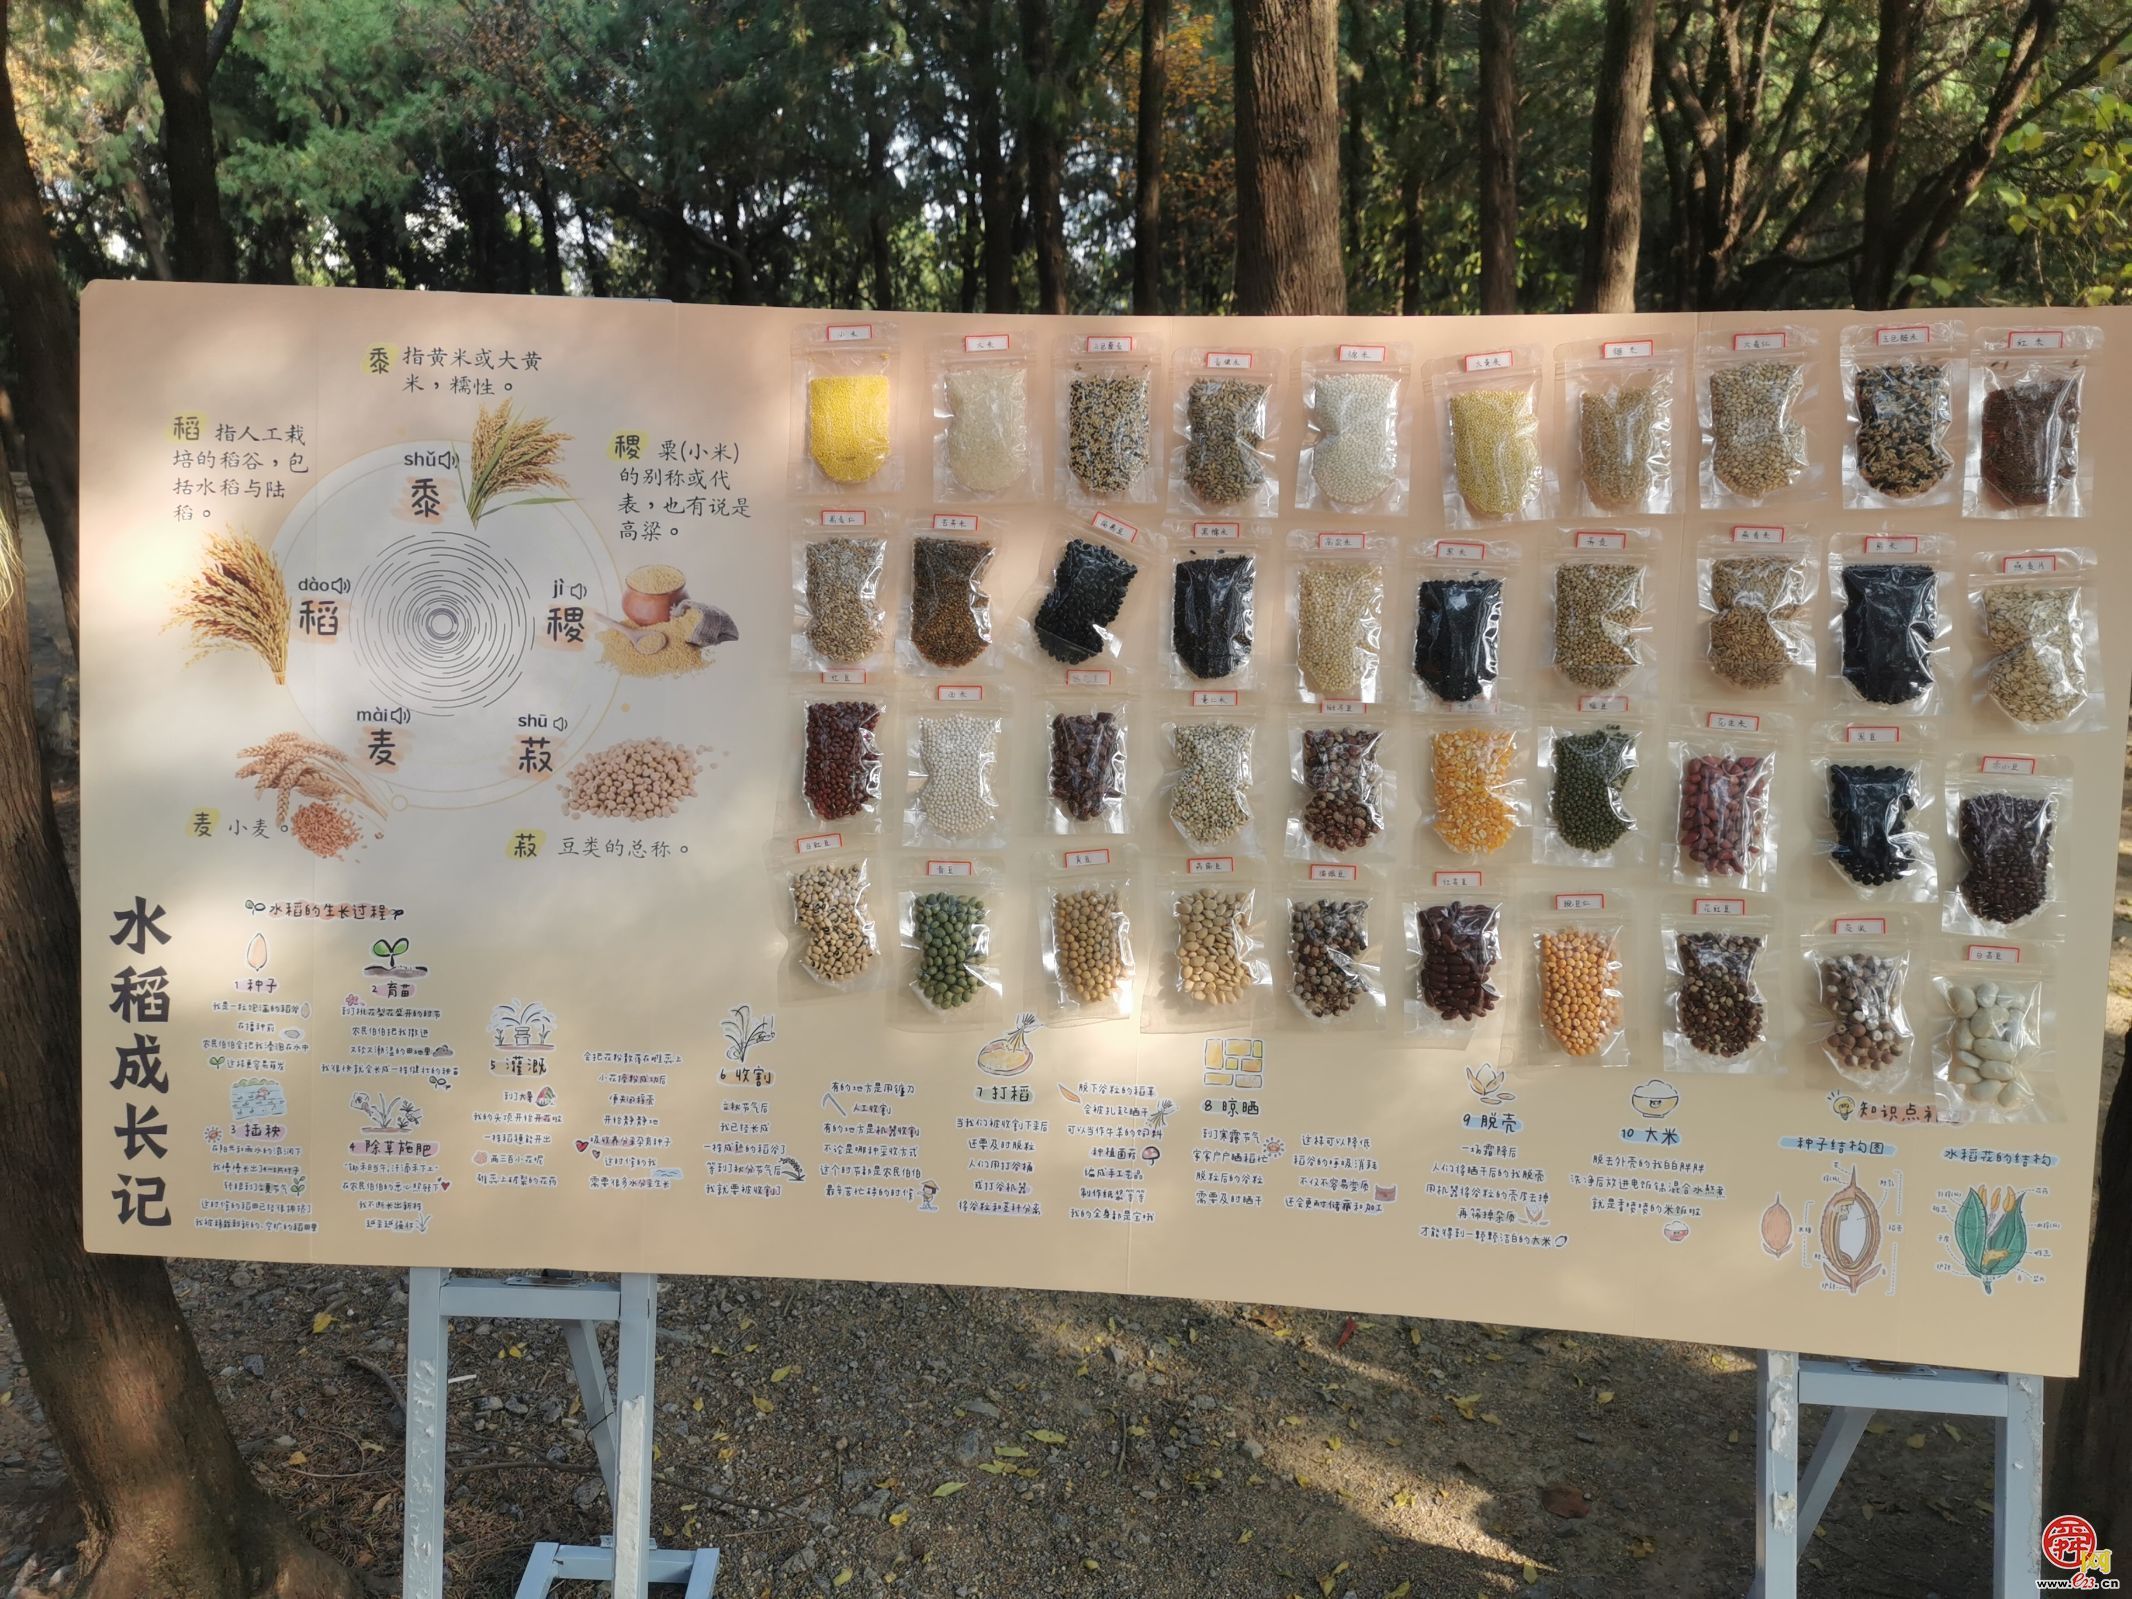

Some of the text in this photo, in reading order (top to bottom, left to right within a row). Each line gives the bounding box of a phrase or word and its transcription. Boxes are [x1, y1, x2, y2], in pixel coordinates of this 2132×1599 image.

[370, 347, 389, 374] 黍
[402, 346, 543, 373] 指黄米或大黄
[173, 415, 200, 441] 稻
[215, 424, 305, 445] 指人工栽
[615, 435, 640, 461] 稷
[173, 477, 286, 498] 括水稻与陆
[619, 467, 731, 491] 的别称或代
[410, 477, 441, 518] 黍
[299, 575, 329, 592] dào
[553, 577, 565, 599] jì
[299, 600, 338, 637] 稻
[547, 605, 585, 642] 稷
[356, 707, 387, 723] mài
[517, 713, 548, 730] shū
[367, 729, 396, 767] 麦
[519, 736, 552, 772] 菽
[193, 812, 211, 837] 麦
[514, 835, 537, 858] 菽
[268, 901, 386, 921] 水稻的生长过程
[248, 978, 277, 993] 种子
[387, 980, 410, 998] 育苗
[109, 896, 172, 1226] 水稻成长记
[506, 1055, 546, 1076] 灌溉
[735, 1066, 772, 1087] 收割
[992, 1085, 1030, 1102] 打稻
[1222, 1098, 1259, 1117] 晾晒
[244, 1123, 280, 1138] 插秧
[1481, 1113, 1517, 1134] 脱壳
[1646, 1127, 1679, 1145] 大米
[1797, 1137, 1884, 1155] 种子结构图
[365, 1140, 432, 1157] 除草施肥
[1944, 1149, 2053, 1168] 水稻花的结构
